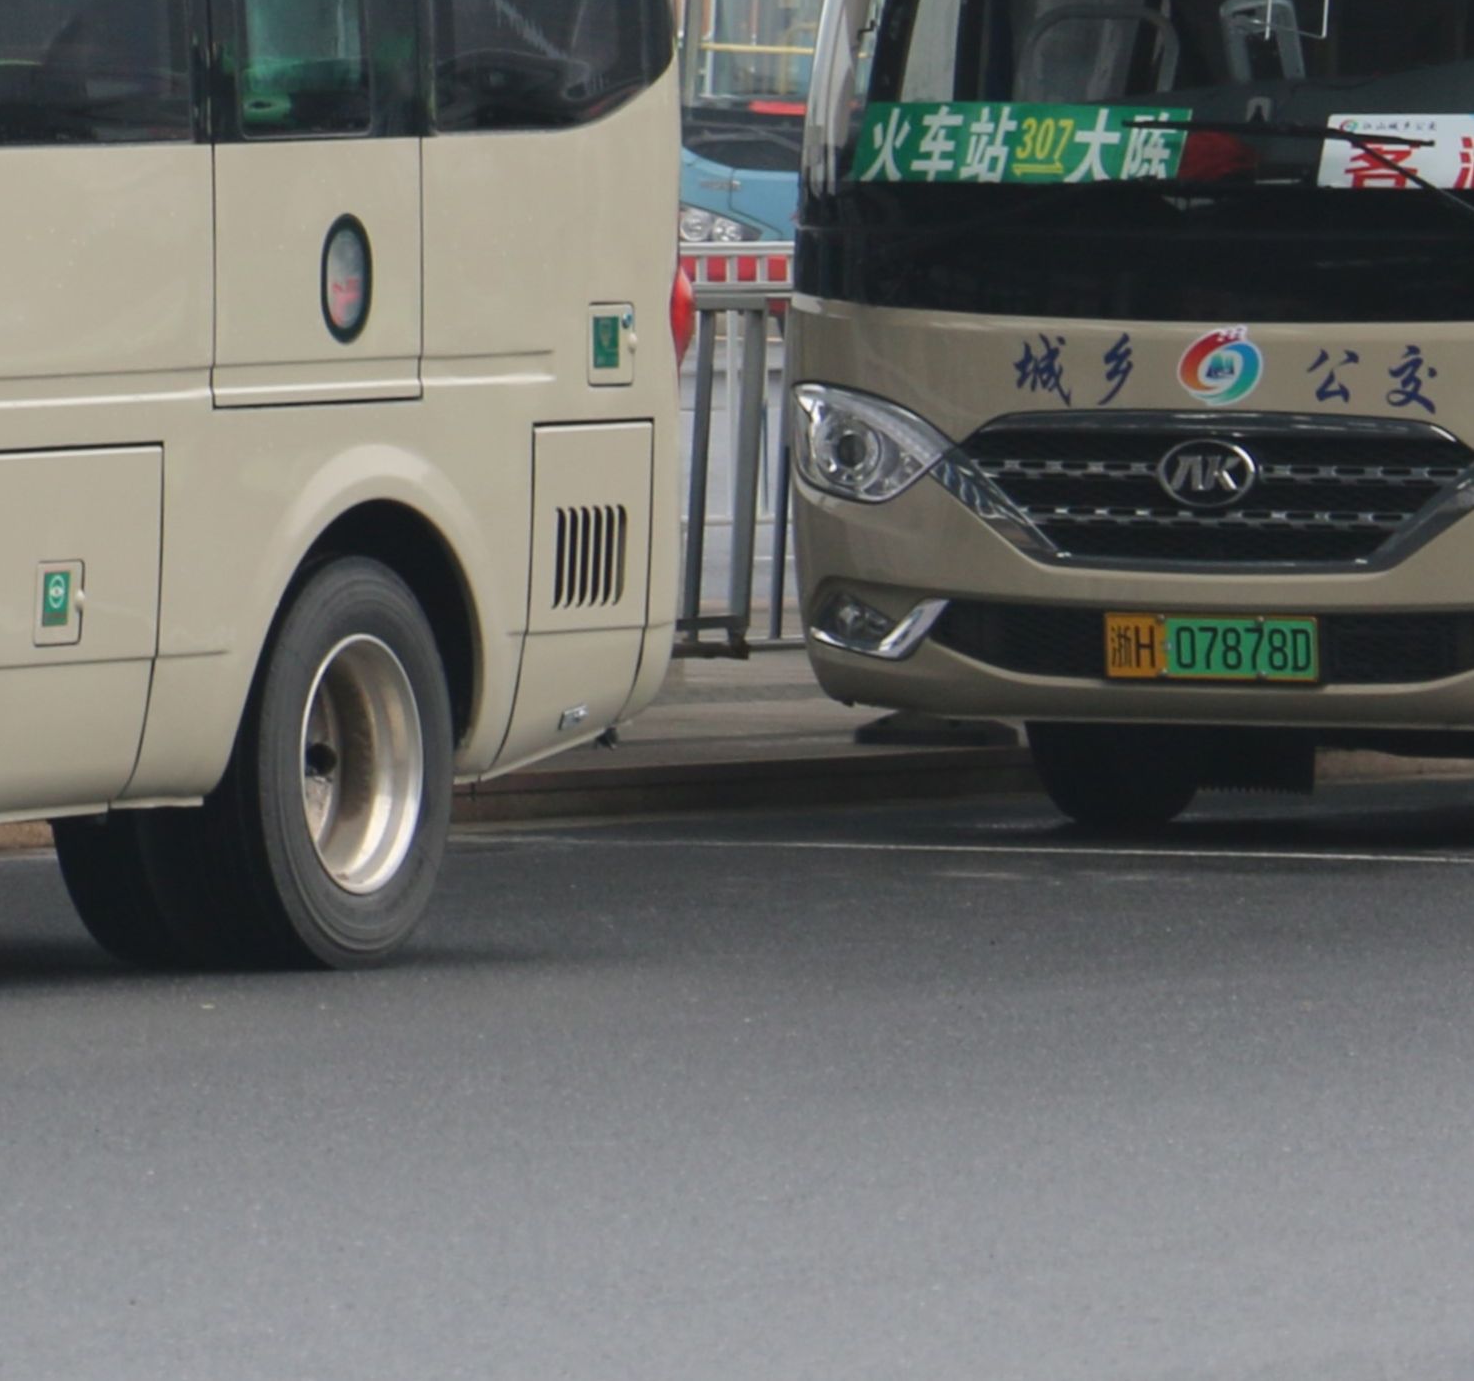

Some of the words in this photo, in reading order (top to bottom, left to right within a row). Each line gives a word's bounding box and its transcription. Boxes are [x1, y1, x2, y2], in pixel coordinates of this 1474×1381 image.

[860, 104, 1019, 183] 火车站
[1015, 118, 1075, 161] 307
[1013, 332, 1135, 407] 城乡
[1306, 344, 1438, 414] 公交
